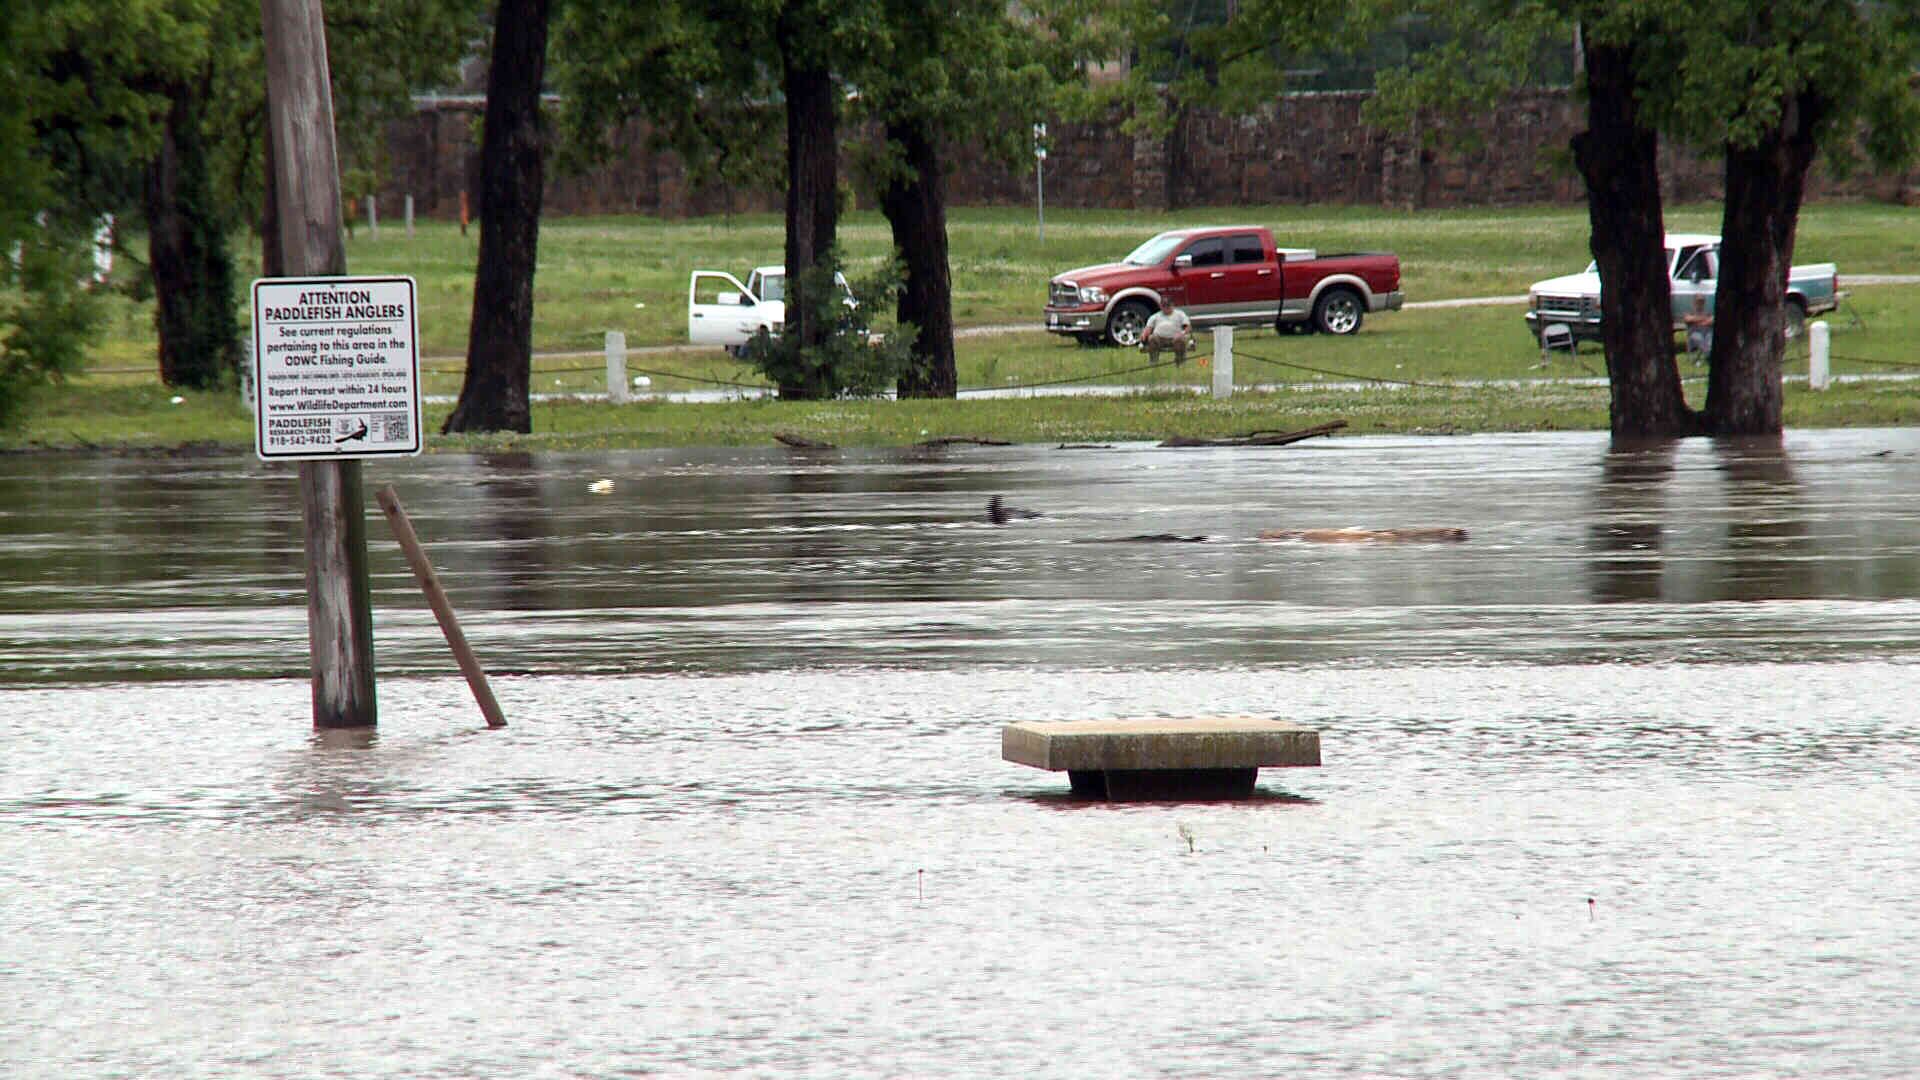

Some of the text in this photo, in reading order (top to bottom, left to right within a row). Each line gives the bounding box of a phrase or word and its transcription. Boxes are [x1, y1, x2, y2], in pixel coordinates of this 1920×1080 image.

[299, 290, 371, 305] ATTENTION
[265, 305, 404, 320] PADDLEFISH ANGLERS
[279, 324, 392, 338] See current regulations
[267, 340, 405, 353] pertaining to this area in the
[320, 355, 353, 367] Fishing
[269, 384, 406, 397] Report Harvest within 24 hours
[269, 399, 407, 411] www.WildlifeDepartment.com
[269, 418, 331, 428] PADDLEFISH
